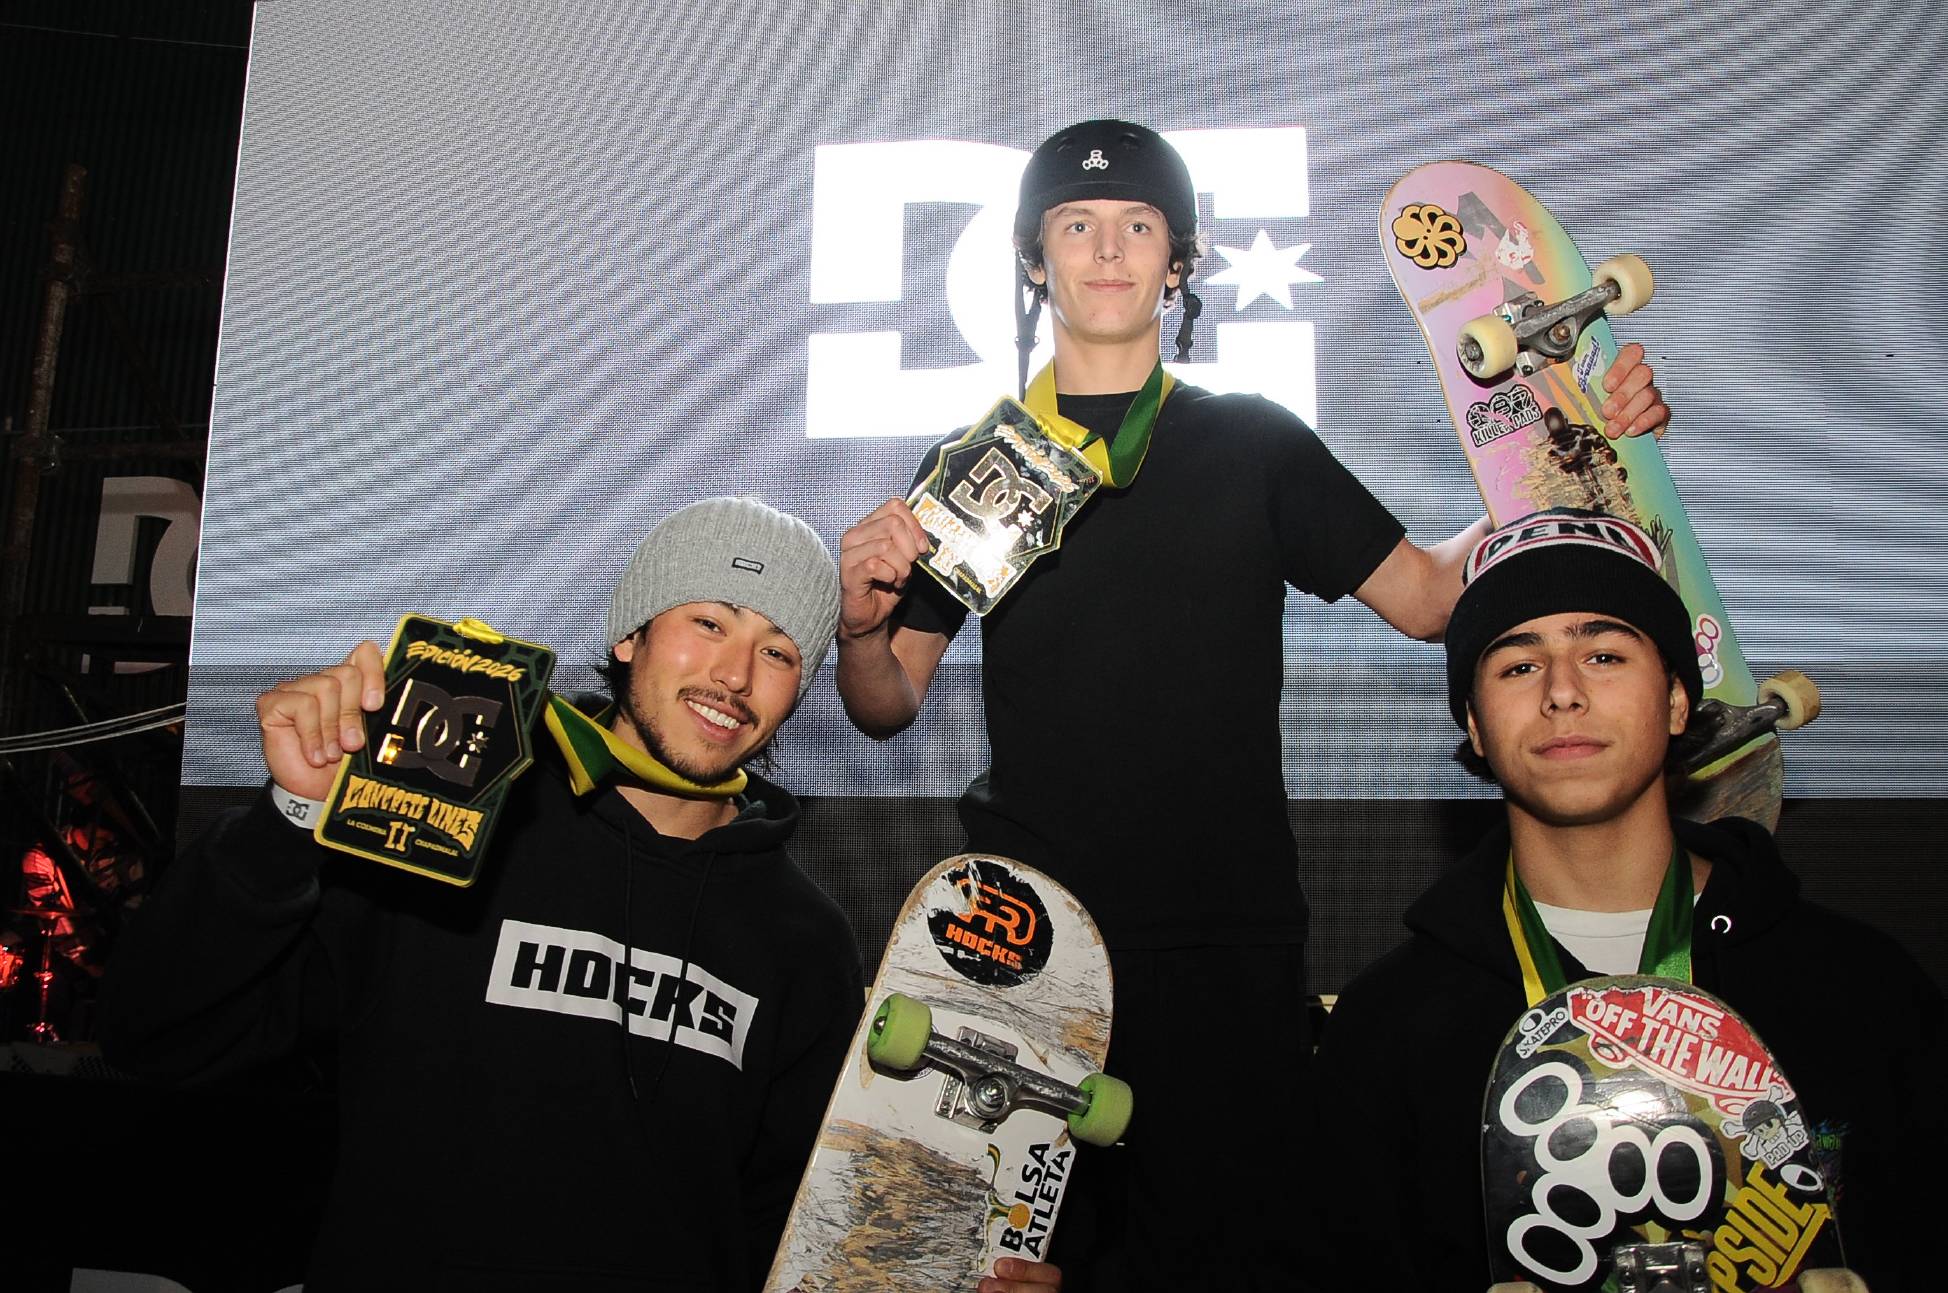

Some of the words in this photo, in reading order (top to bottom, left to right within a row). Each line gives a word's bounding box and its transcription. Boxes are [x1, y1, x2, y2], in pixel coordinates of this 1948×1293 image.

[1512, 405, 1542, 429] PADS
[945, 923, 1024, 970] HOCKS
[510, 941, 737, 1047] HOCKS
[1642, 988, 1722, 1041] VANS
[1519, 1011, 1566, 1056] SKATEPRO
[1637, 1016, 1699, 1076] THE
[1764, 1142, 1791, 1166] PAD
[1787, 1129, 1806, 1149] UP
[1023, 1150, 1072, 1259] ATLETA
[1707, 1161, 1815, 1293] PSIDE
